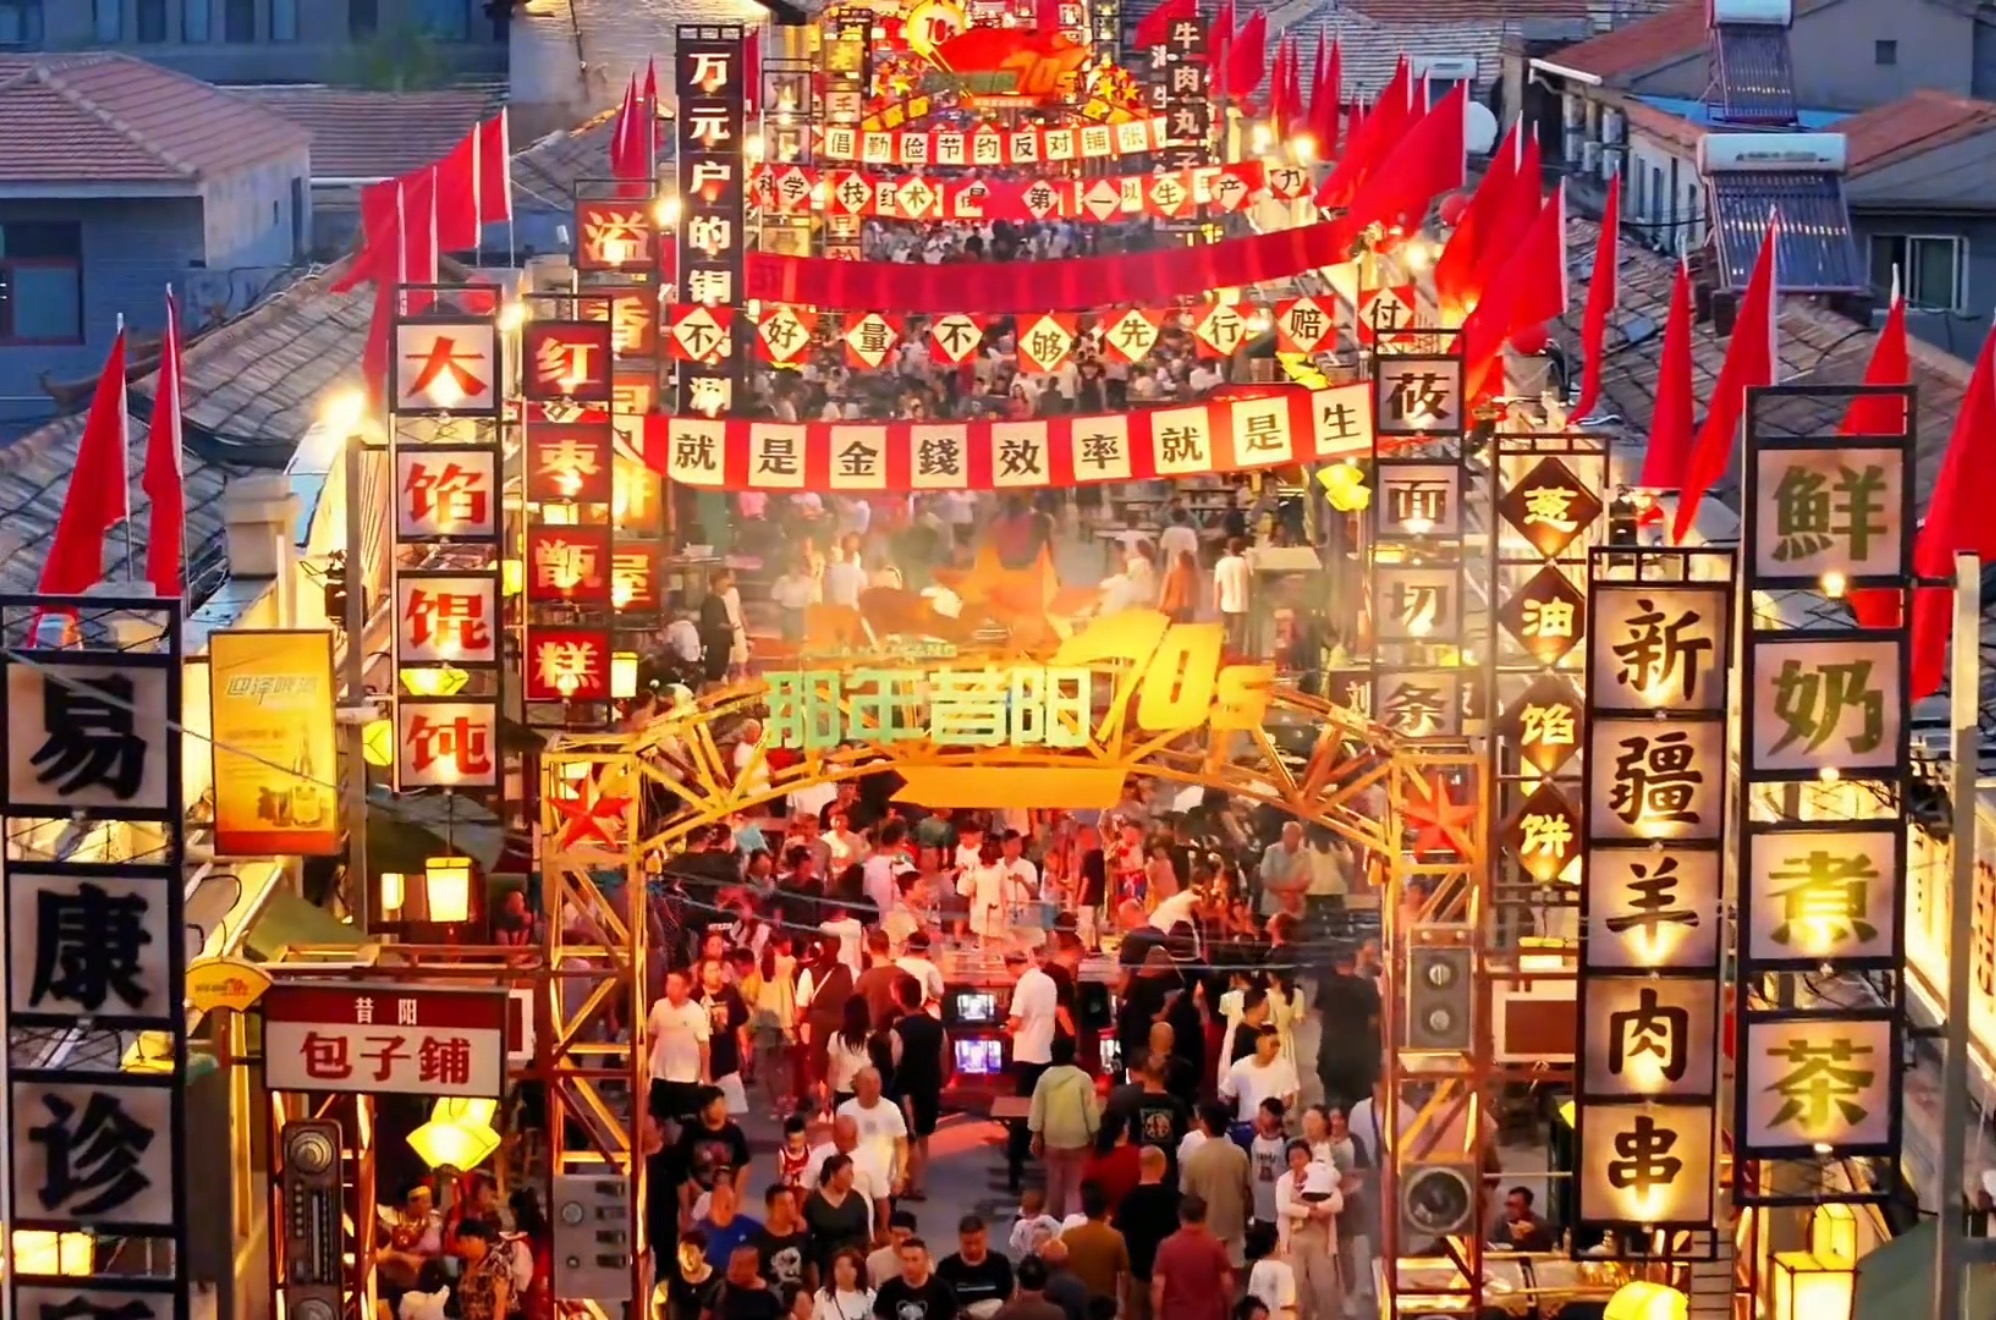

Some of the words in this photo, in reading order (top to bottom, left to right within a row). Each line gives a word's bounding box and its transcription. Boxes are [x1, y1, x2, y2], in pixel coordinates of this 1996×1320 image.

[688, 53, 731, 412] 万元户的铜涮
[830, 122, 1164, 159] 倡勤俭节约反对铺张
[1172, 22, 1200, 170] 牛肉丸子
[622, 404, 1362, 477] 就是金錢效率就是生
[683, 298, 1402, 363] 不好量不够先行赔付
[404, 335, 491, 775] 大馅馄饨
[535, 336, 603, 689] 红枣甑糕
[762, 664, 1090, 748] 那年昔阳
[1049, 610, 1277, 742] 70s
[1384, 372, 1451, 732] 莜面切条
[1521, 486, 1578, 858] 葱油馅饼
[28, 672, 155, 1320] 易康诊
[355, 996, 418, 1026] 昔阳
[1605, 599, 1712, 1198] 新疆羊肉串
